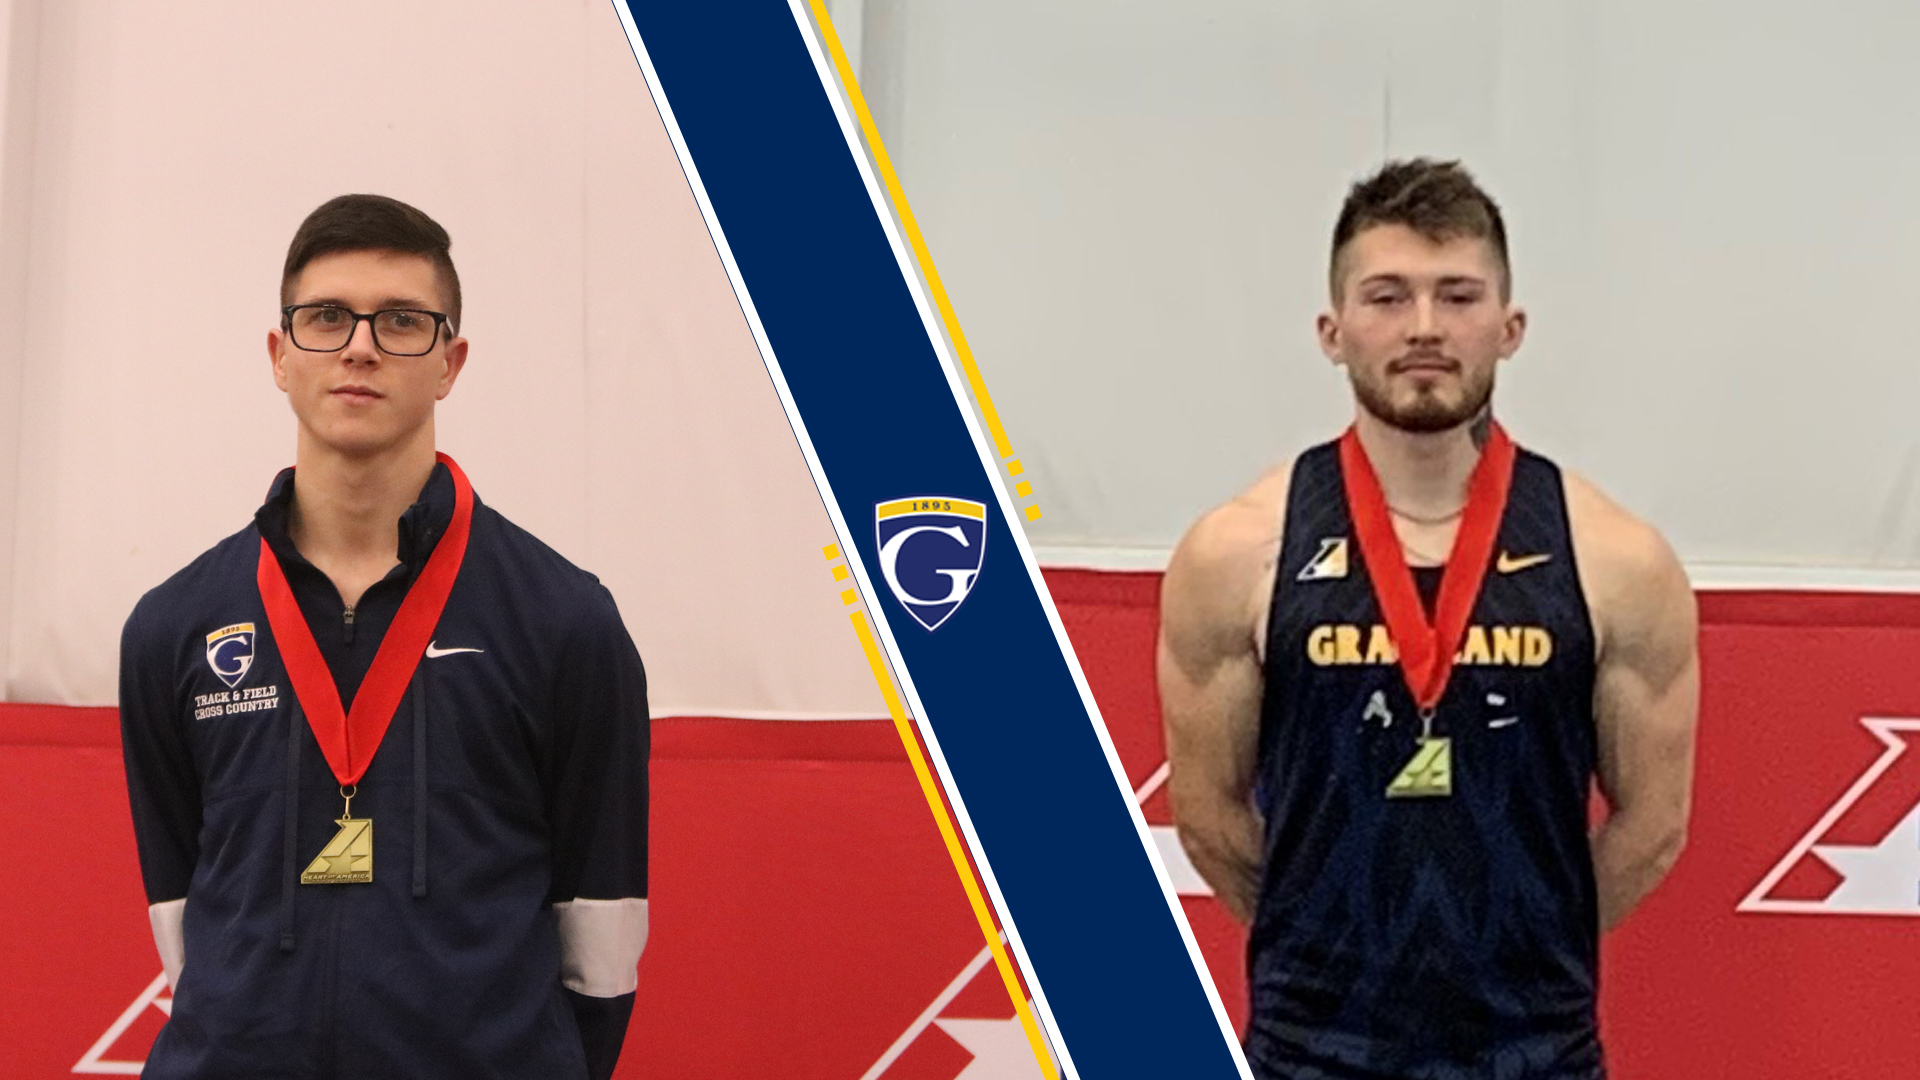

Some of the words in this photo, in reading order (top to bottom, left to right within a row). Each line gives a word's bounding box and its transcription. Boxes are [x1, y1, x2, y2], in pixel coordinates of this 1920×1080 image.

[207, 635, 253, 676] G
[1307, 624, 1553, 667] GRAAND
[194, 704, 223, 720] CROSS
[225, 697, 279, 714] COUNTRY
[195, 692, 230, 707] TRACK
[232, 690, 240, 701] &
[242, 685, 277, 700] FIELD
